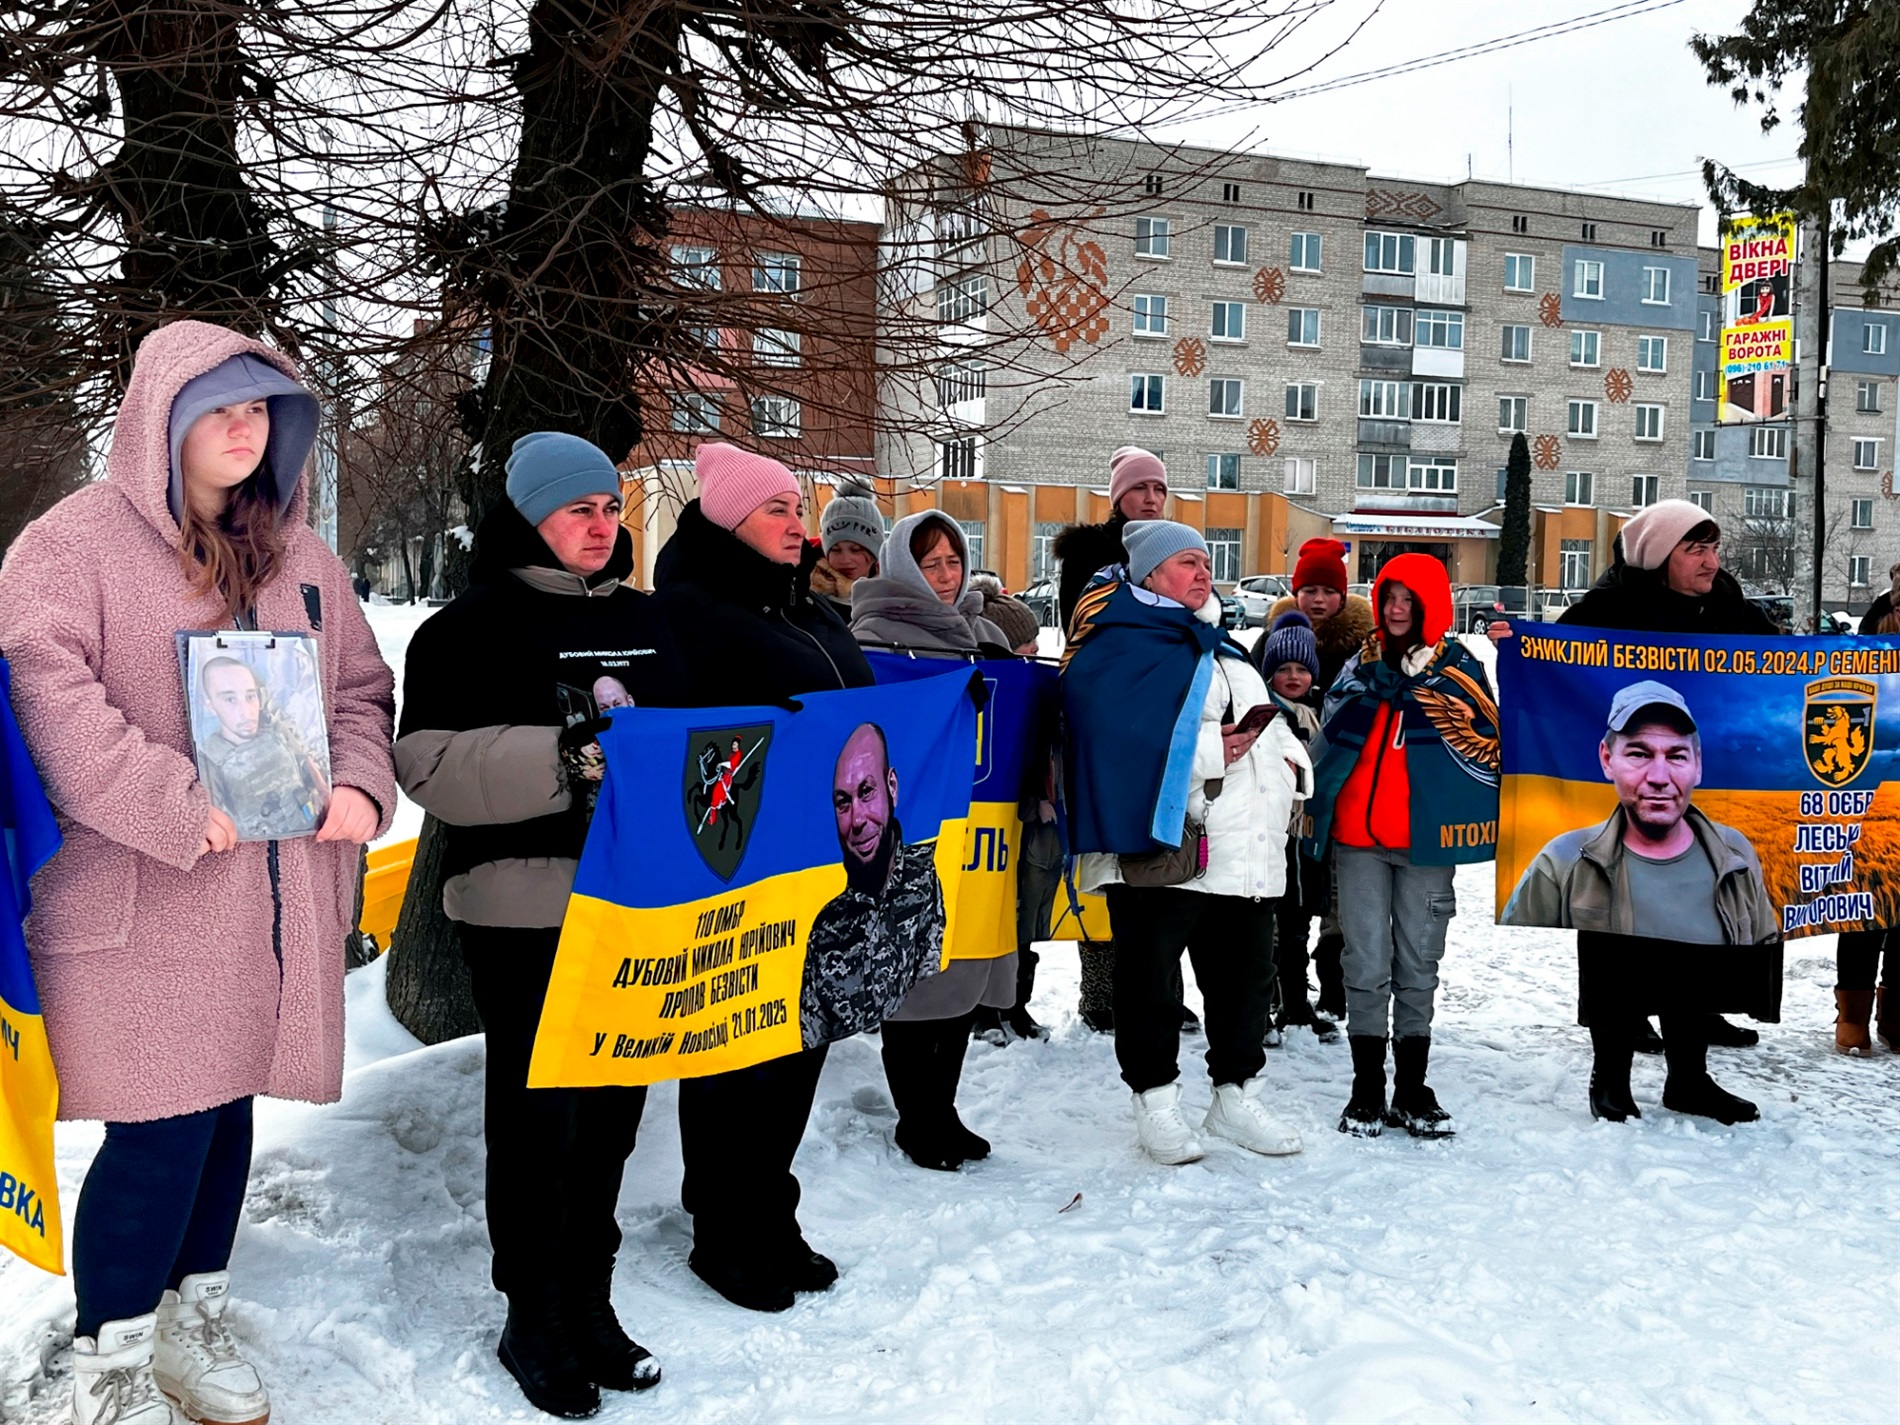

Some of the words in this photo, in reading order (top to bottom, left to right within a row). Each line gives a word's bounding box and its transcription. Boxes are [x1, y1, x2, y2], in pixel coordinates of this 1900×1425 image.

[1729, 238, 1788, 261] ВІКНА
[1729, 259, 1788, 284] ДВЕРІ
[1726, 329, 1786, 346] ГАРАЖНІ
[1728, 344, 1782, 360] ВОРОТА
[1520, 635, 1608, 667] ЗНИКЛИЙ
[1613, 644, 1700, 672] БЕЗВІСТИ
[1829, 648, 1900, 675] СЕМЕНІ
[1800, 791, 1823, 816] 68
[962, 827, 1009, 872] ЛЬ
[695, 909, 716, 940] 110
[713, 900, 746, 936] ОМБР
[612, 947, 689, 989] ДУБОВИЙ
[692, 937, 735, 978] МИКОЛА
[739, 919, 796, 961] ЮРІЙОВИЧ
[658, 981, 706, 1019] ПРОПАВ
[710, 963, 759, 1006] БЕЗВІСТИ
[589, 1032, 608, 1056] У
[731, 998, 787, 1040] 21.01.2025
